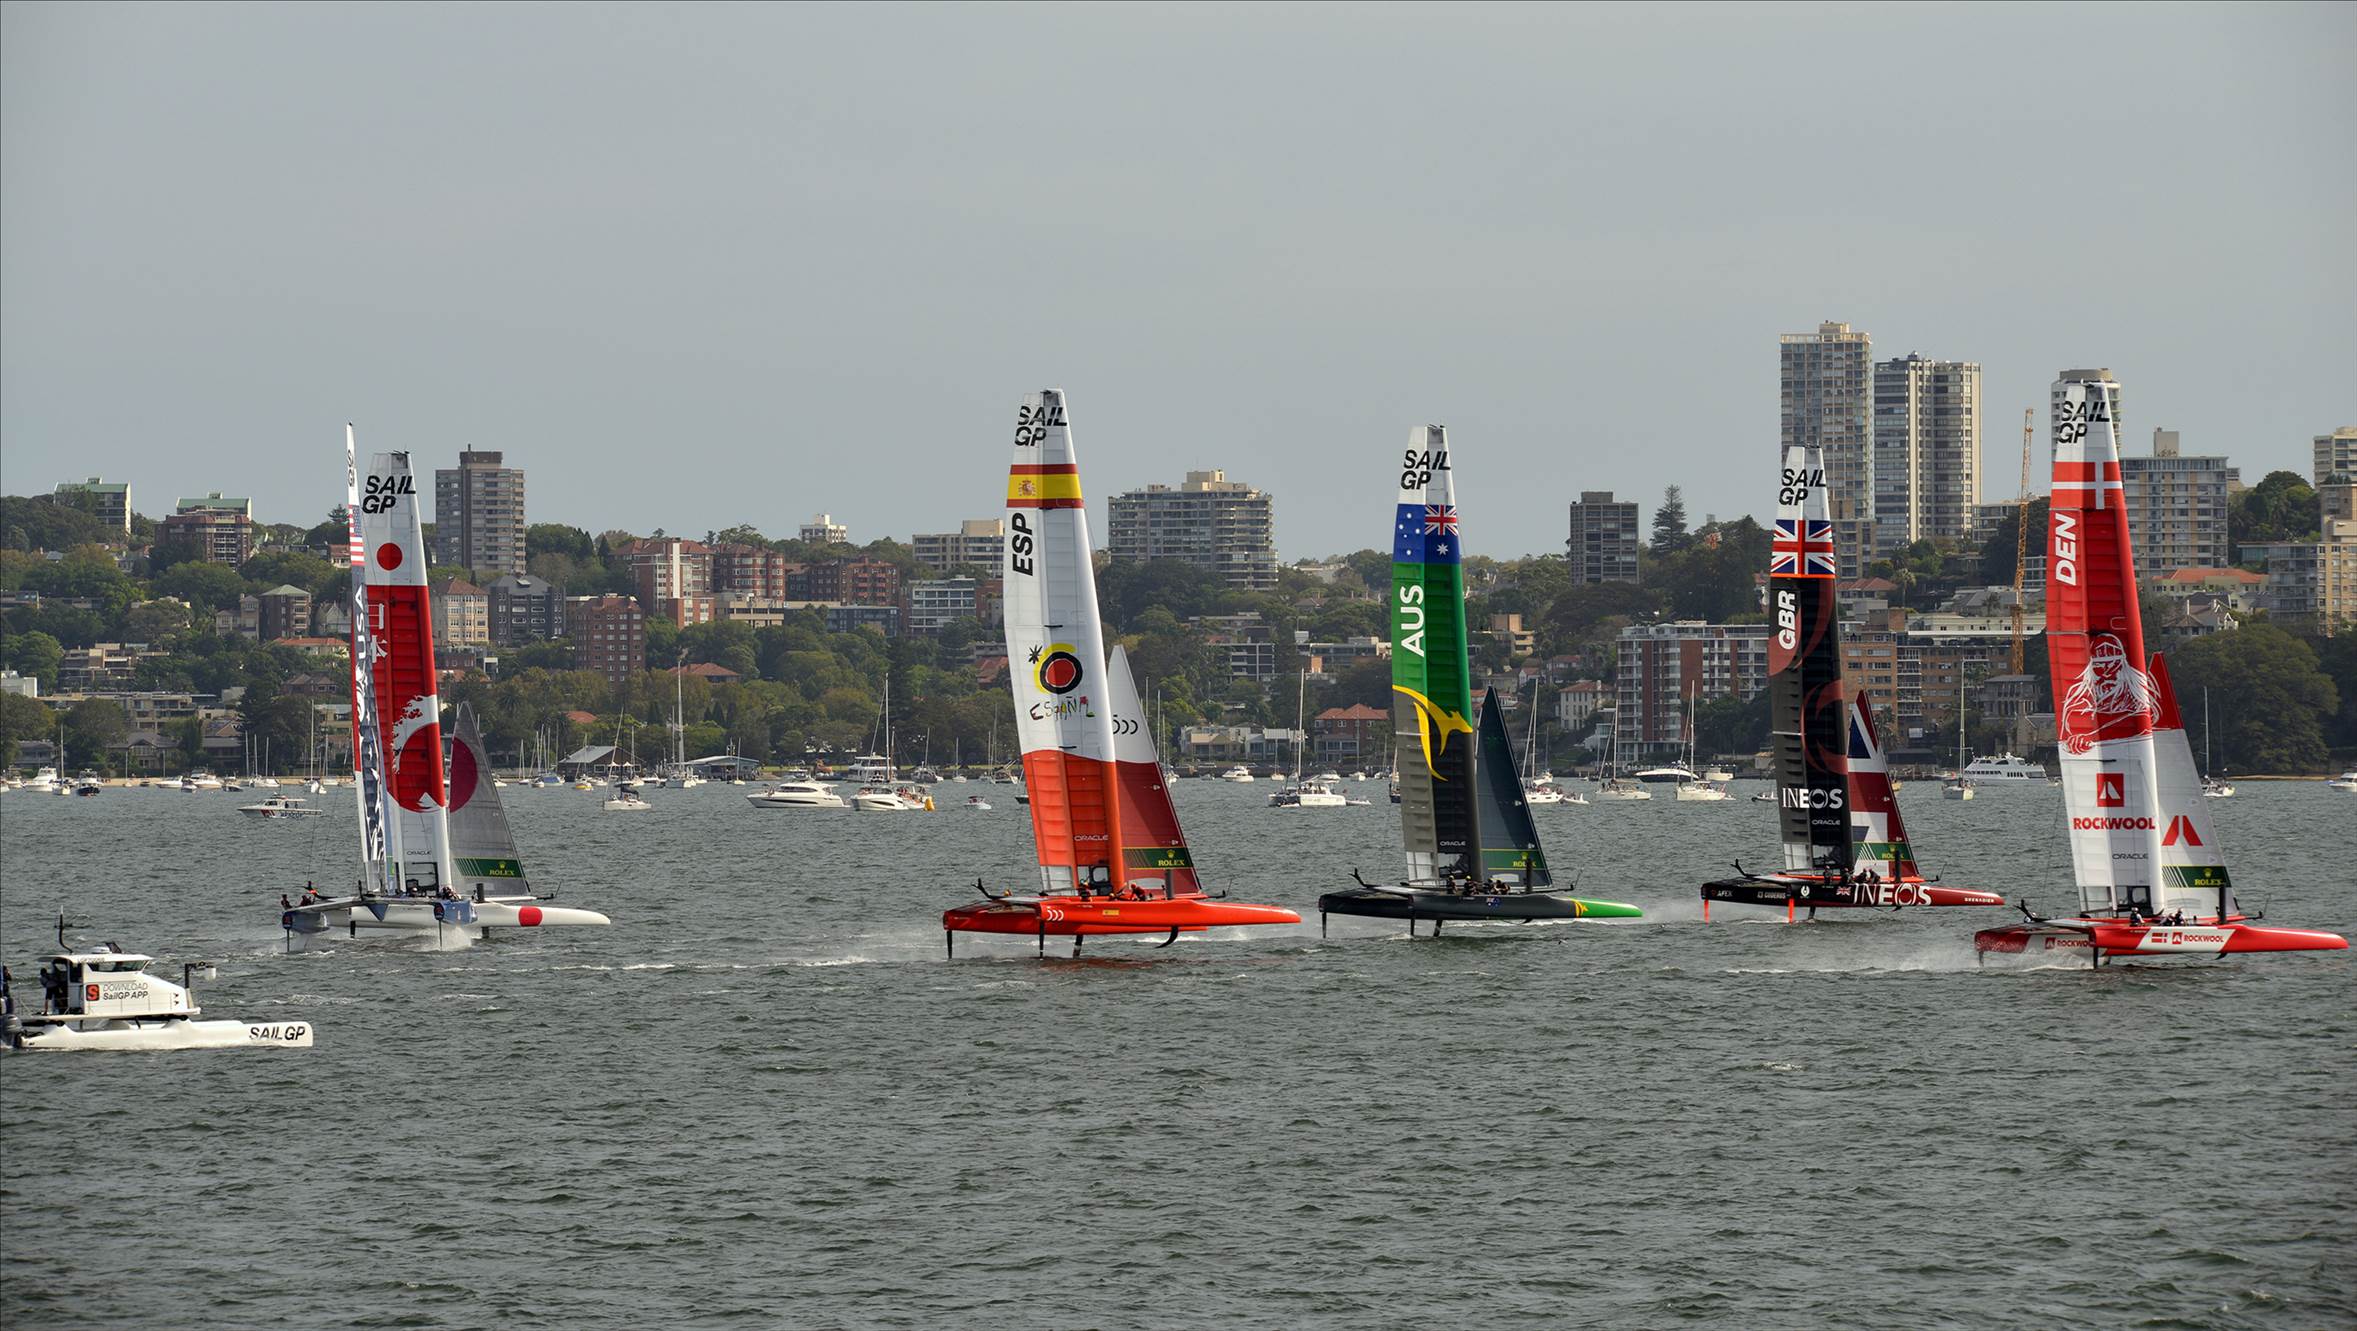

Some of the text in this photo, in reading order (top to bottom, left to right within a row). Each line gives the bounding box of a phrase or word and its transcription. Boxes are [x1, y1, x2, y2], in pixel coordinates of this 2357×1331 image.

[1018, 405, 1067, 426] SAIL
[2061, 401, 2110, 422] SAIL
[1014, 426, 1047, 446] GP
[2057, 422, 2088, 443] GP
[1403, 450, 1450, 470] SAIL
[365, 475, 417, 494] SAIL
[1400, 470, 1431, 489] GP
[1781, 469, 1826, 487] SAIL
[362, 495, 396, 514] GP
[1778, 487, 1809, 505] GP
[1011, 512, 1033, 576] ESP
[2055, 513, 2076, 585] DEN
[355, 584, 366, 659] USA
[1401, 584, 1424, 657] AUS
[1778, 590, 1796, 650] GBR
[1782, 788, 1843, 809] INEOS
[2073, 818, 2155, 830] ROCKWOOL
[1853, 883, 1932, 906] INEOS
[2184, 934, 2224, 943] ROCKWOOL
[103, 983, 148, 991] DOWNLOAD
[131, 991, 148, 999] APP
